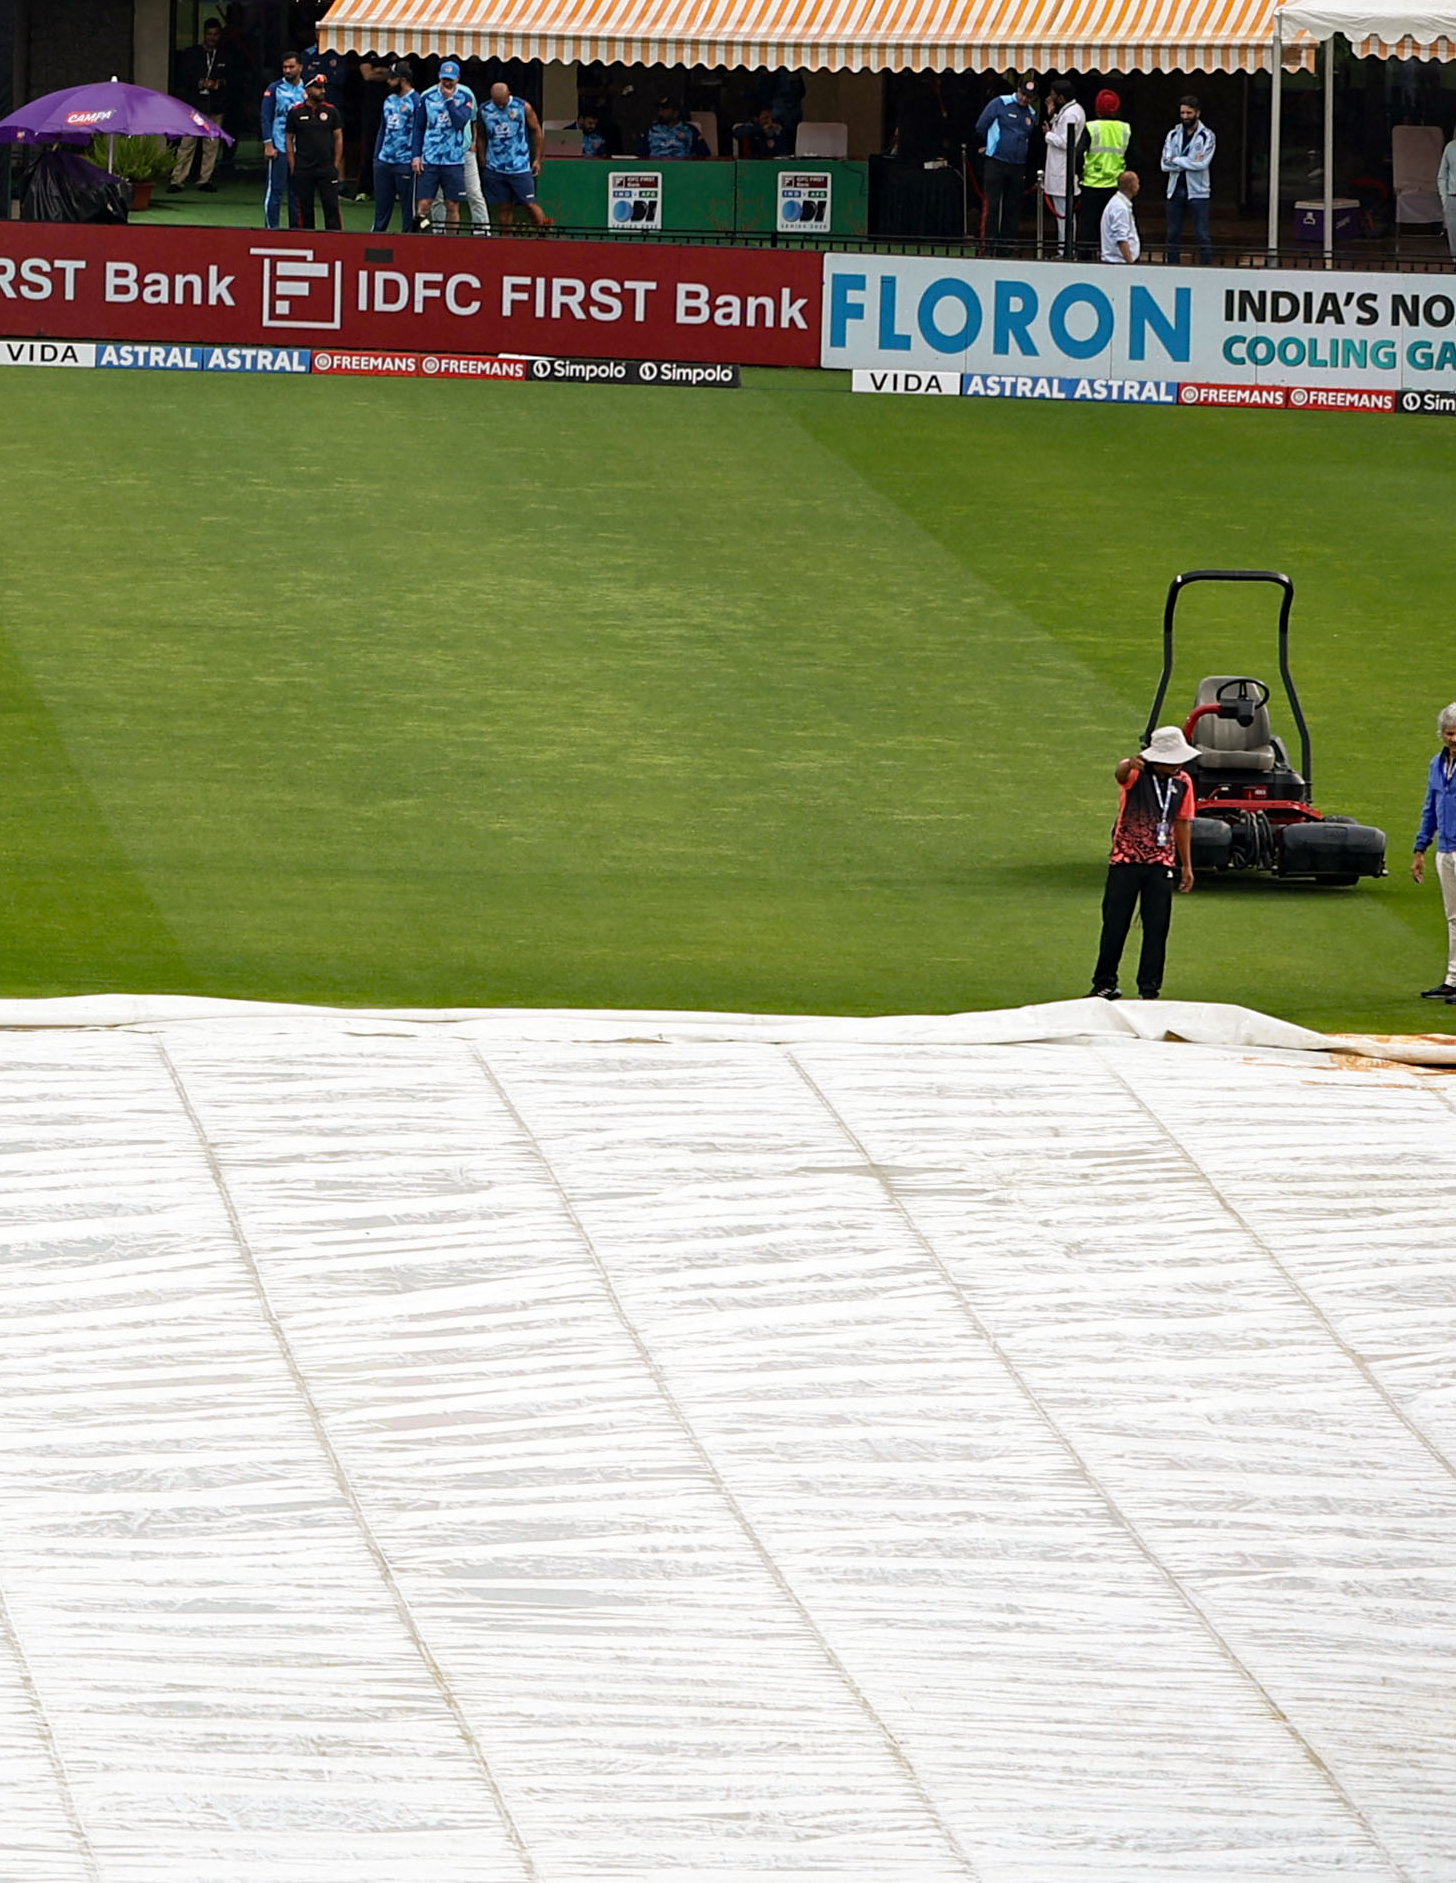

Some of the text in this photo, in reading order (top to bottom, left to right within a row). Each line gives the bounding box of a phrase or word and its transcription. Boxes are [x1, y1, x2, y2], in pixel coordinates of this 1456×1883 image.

[104, 261, 235, 307] Bank
[358, 270, 808, 329] IDFC FIRST Bank
[830, 272, 1191, 363] FLORON
[7, 344, 79, 363] VIDA
[100, 345, 198, 368] ASTRAL
[208, 348, 305, 372] ASTRAL
[332, 354, 416, 372] FREEMANS
[1223, 334, 1397, 370] COOLING
[440, 359, 524, 378] FREEMANS
[554, 359, 626, 380] Simpolo
[659, 363, 732, 384] Simpolo
[870, 372, 943, 393] VIDA
[968, 374, 1066, 398] ASTRAL
[1076, 377, 1174, 402] ASTRAL
[1199, 387, 1284, 406] FREEMANS
[1308, 390, 1393, 409] FREEMANS
